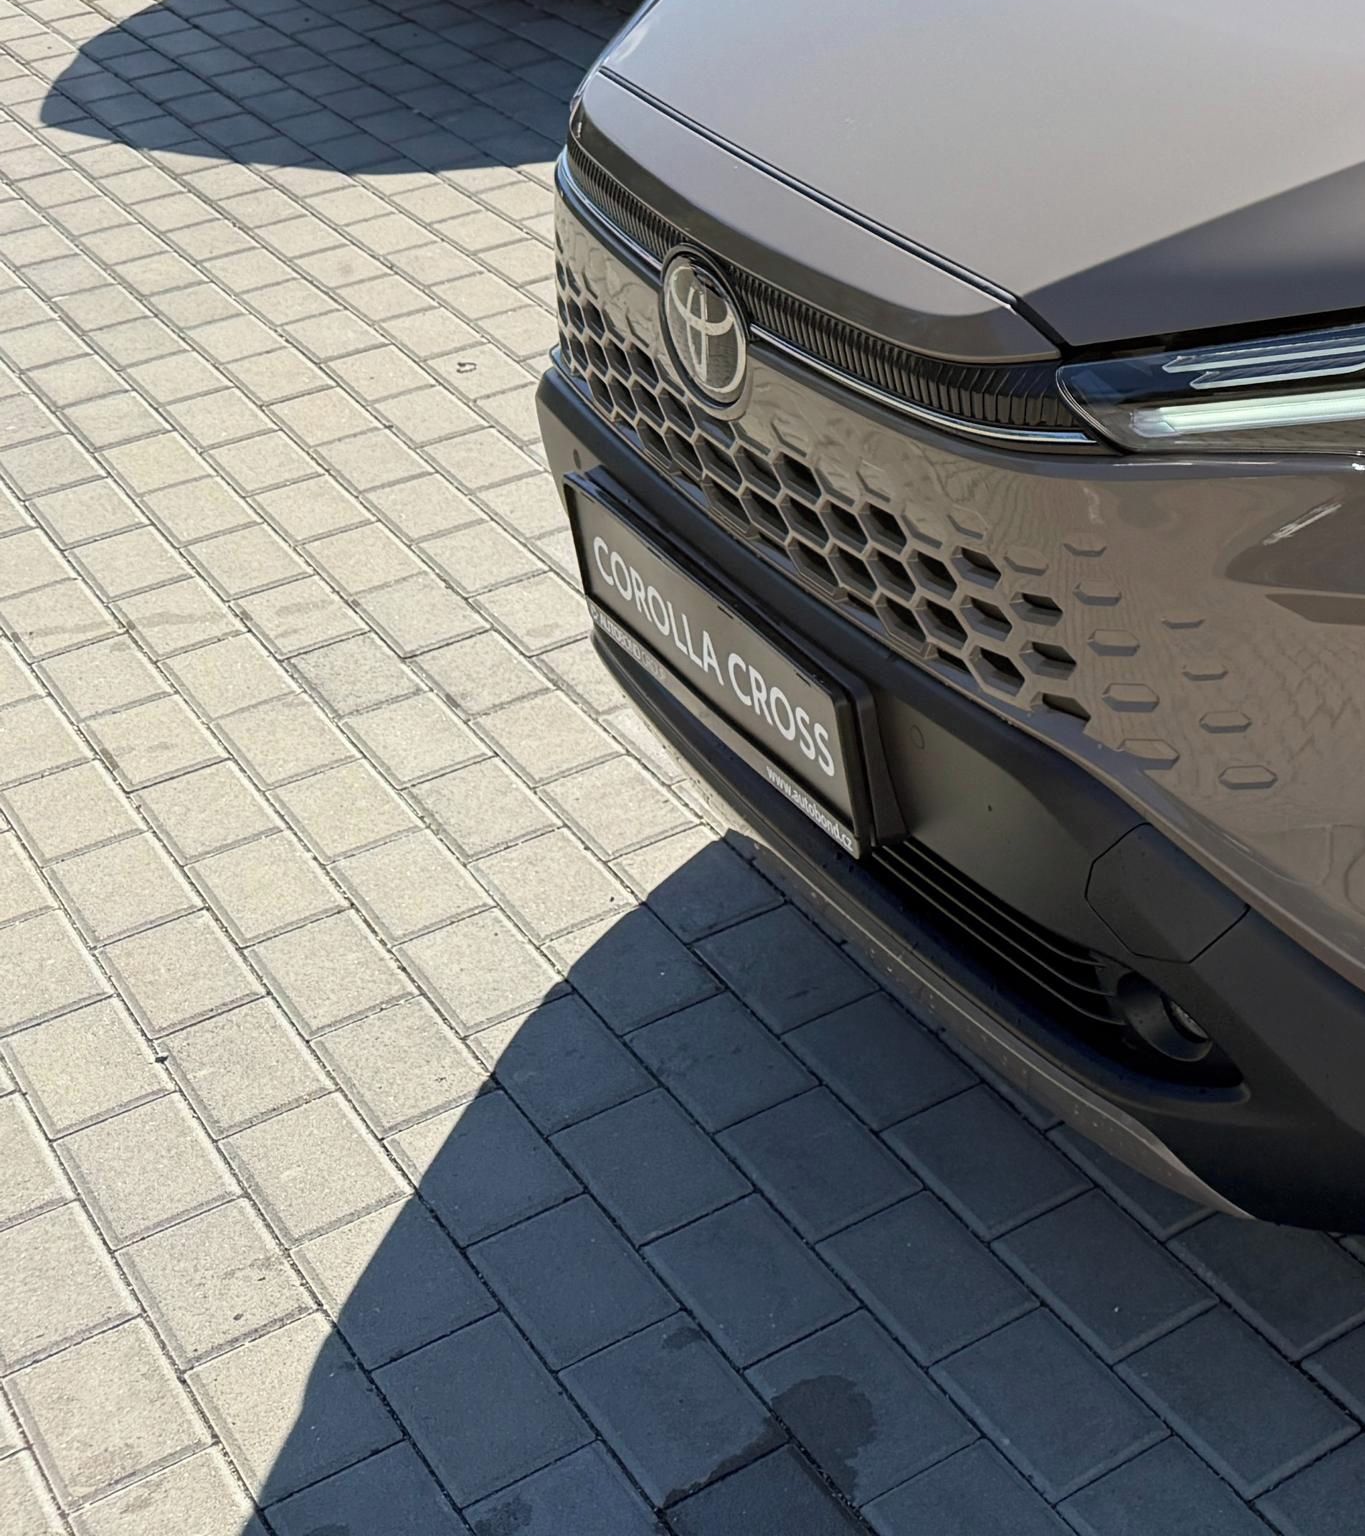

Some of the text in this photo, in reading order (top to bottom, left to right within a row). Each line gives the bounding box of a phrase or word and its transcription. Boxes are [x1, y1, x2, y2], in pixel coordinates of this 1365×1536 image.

[593, 536, 835, 777] COROLLA CROSS
[766, 765, 854, 851] www.autobond.cz
